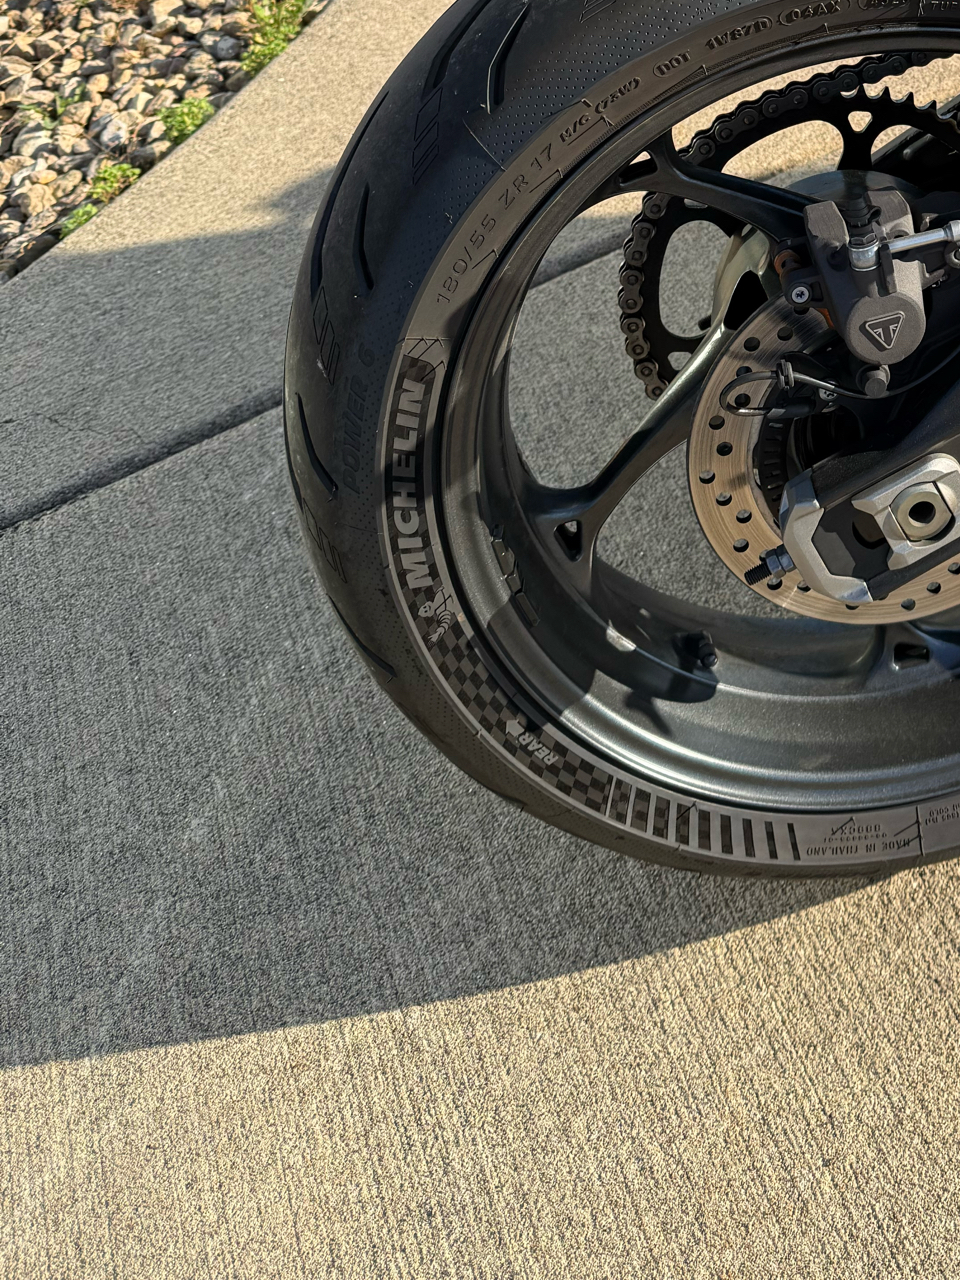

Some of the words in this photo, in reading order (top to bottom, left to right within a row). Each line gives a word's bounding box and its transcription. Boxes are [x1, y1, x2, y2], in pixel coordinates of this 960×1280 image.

[655, 51, 691, 76] DOT
[436, 213, 497, 304] 180/55
[498, 174, 529, 210] ZR
[530, 142, 553, 171] 17
[342, 374, 370, 495] POWER
[358, 343, 376, 368] 6
[392, 378, 434, 590] MICHELIN
[517, 731, 559, 766] REAR
[806, 843, 859, 857] THAILAND
[865, 842, 877, 854] IN
